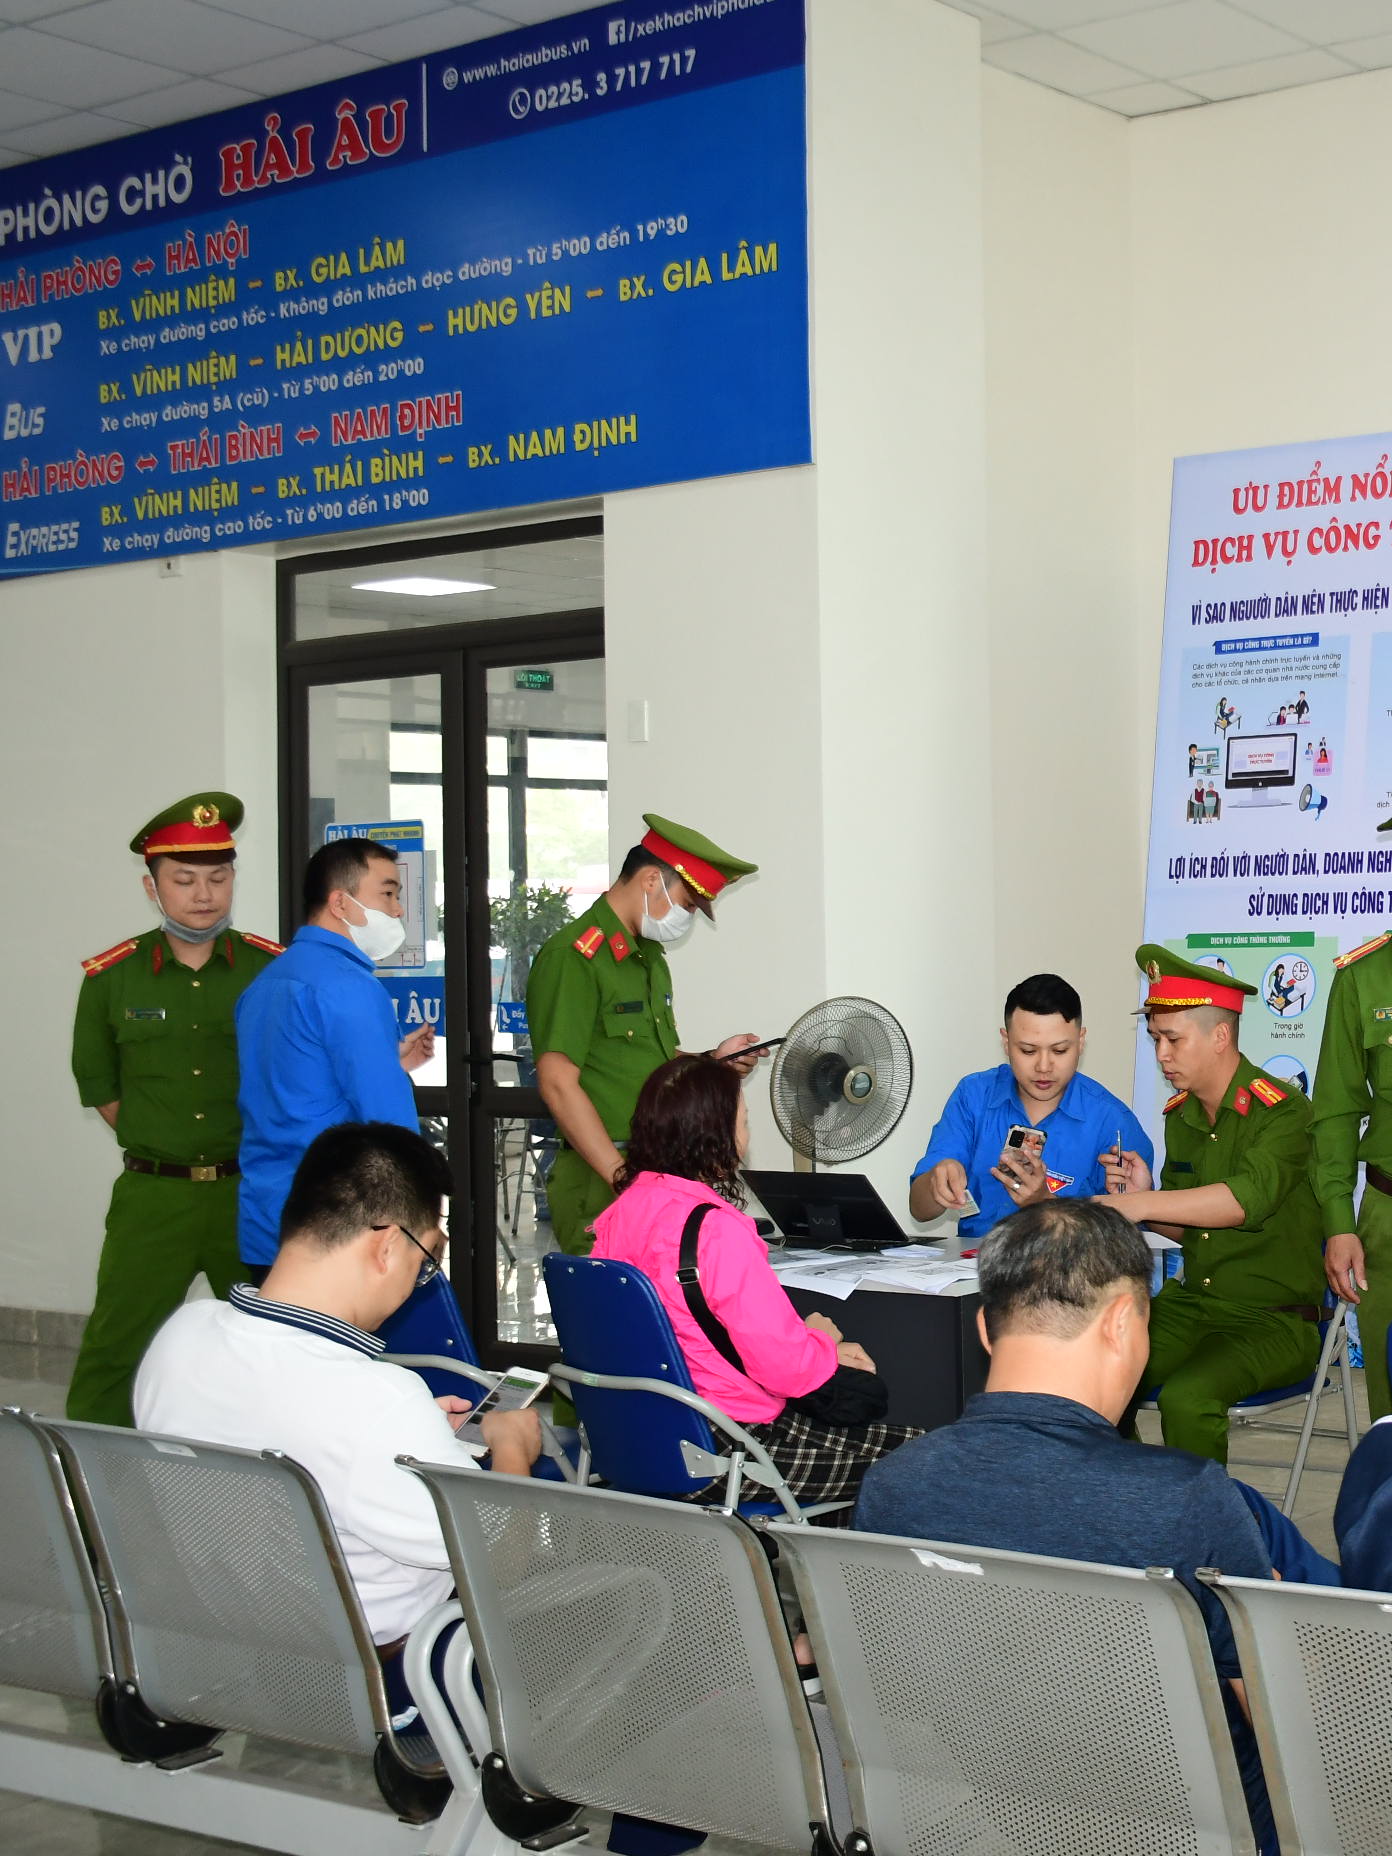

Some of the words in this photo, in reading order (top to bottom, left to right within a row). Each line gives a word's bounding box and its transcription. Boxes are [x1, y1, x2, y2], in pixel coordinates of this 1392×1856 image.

[462, 37, 590, 85] www.haiaubus.vn
[535, 82, 589, 112] 0225.
[595, 73, 608, 96] 3
[615, 60, 651, 92] 717
[658, 48, 697, 81] 717
[0, 185, 109, 246] PHÒNG
[119, 154, 193, 216] CHỜ
[218, 113, 315, 197] HẢI
[326, 98, 408, 171] ÂU
[0, 267, 36, 312] HẢI
[42, 255, 122, 303] PHÒNG
[165, 229, 200, 275] HÀ
[205, 219, 250, 270] NỘI
[98, 306, 125, 331] BX.
[131, 287, 181, 327] VĨNH
[185, 274, 236, 315] NIỆM
[274, 267, 304, 293] BX.
[310, 252, 352, 284] GIA
[358, 236, 406, 276] LÂM
[100, 338, 118, 357] Xe
[121, 333, 156, 355] chạy
[160, 323, 206, 348] đường
[210, 316, 238, 335] cao
[243, 302, 267, 330] tốc
[279, 293, 328, 320] Không
[333, 282, 363, 306] đón
[367, 274, 417, 302] khách
[422, 270, 453, 293] dọc
[459, 255, 513, 284] đường
[527, 244, 547, 267] Từ
[596, 223, 630, 252] đến
[2, 322, 63, 367] VIP
[99, 381, 126, 404] BX.
[132, 362, 181, 398] VĨNH
[186, 351, 237, 391] NIỆM
[275, 331, 314, 370] HẢI
[319, 318, 405, 361] DƯƠNG
[447, 296, 518, 337] HƯNG
[525, 280, 572, 320] YÊN
[618, 274, 655, 302] BX.
[662, 256, 713, 292] GIA
[720, 240, 779, 282] LÂM
[101, 416, 119, 433] Xe
[122, 410, 158, 432] chạy
[162, 397, 209, 422] đường
[213, 395, 233, 412] 5A
[237, 386, 270, 413] (cũ)
[282, 376, 301, 399] Từ
[343, 360, 374, 389] đến
[2, 456, 40, 502] HẢI
[44, 447, 125, 494] PHÒNG
[167, 429, 221, 474] THÁI
[226, 419, 283, 463] BÌNH
[331, 405, 391, 447] NAM
[396, 390, 463, 441] ĐỊNH
[101, 504, 128, 527] BX.
[133, 487, 183, 522] VĨNH
[189, 477, 239, 518] NIỆM
[277, 476, 307, 499] BX.
[312, 454, 363, 495] THÁI
[370, 445, 425, 484] BÌNH
[468, 444, 500, 469] BX.
[508, 427, 565, 463] NAM
[573, 413, 638, 457] ĐỊNH
[1232, 481, 1269, 516] ƯU
[1276, 460, 1343, 511] ĐIỂM
[1191, 535, 1254, 574] DỊCH
[1263, 527, 1300, 567] VỤ
[1306, 517, 1381, 555] CÔNG
[1191, 600, 1202, 626] VÌ
[1204, 601, 1226, 624] SAO
[1274, 591, 1298, 619] DÂN
[1301, 588, 1326, 616] NÊN
[1329, 588, 1358, 617] THỰC
[1361, 582, 1389, 614] HIỆN
[1168, 857, 1186, 885] LỢI
[1188, 851, 1208, 879] ÍCH
[1210, 848, 1230, 879] ĐỐI
[1232, 851, 1251, 878] VỚI
[1253, 848, 1290, 877] NGƯỜI
[1292, 848, 1320, 878] DÂN,
[1323, 851, 1364, 875] DOANH
[1248, 886, 1265, 917] SỬ
[1267, 893, 1298, 921] DỤNG
[1301, 892, 1329, 921] DỊCH
[1332, 891, 1348, 920] VỤ
[1351, 886, 1384, 915] CÔNG
[405, 990, 441, 1024] ÂU
